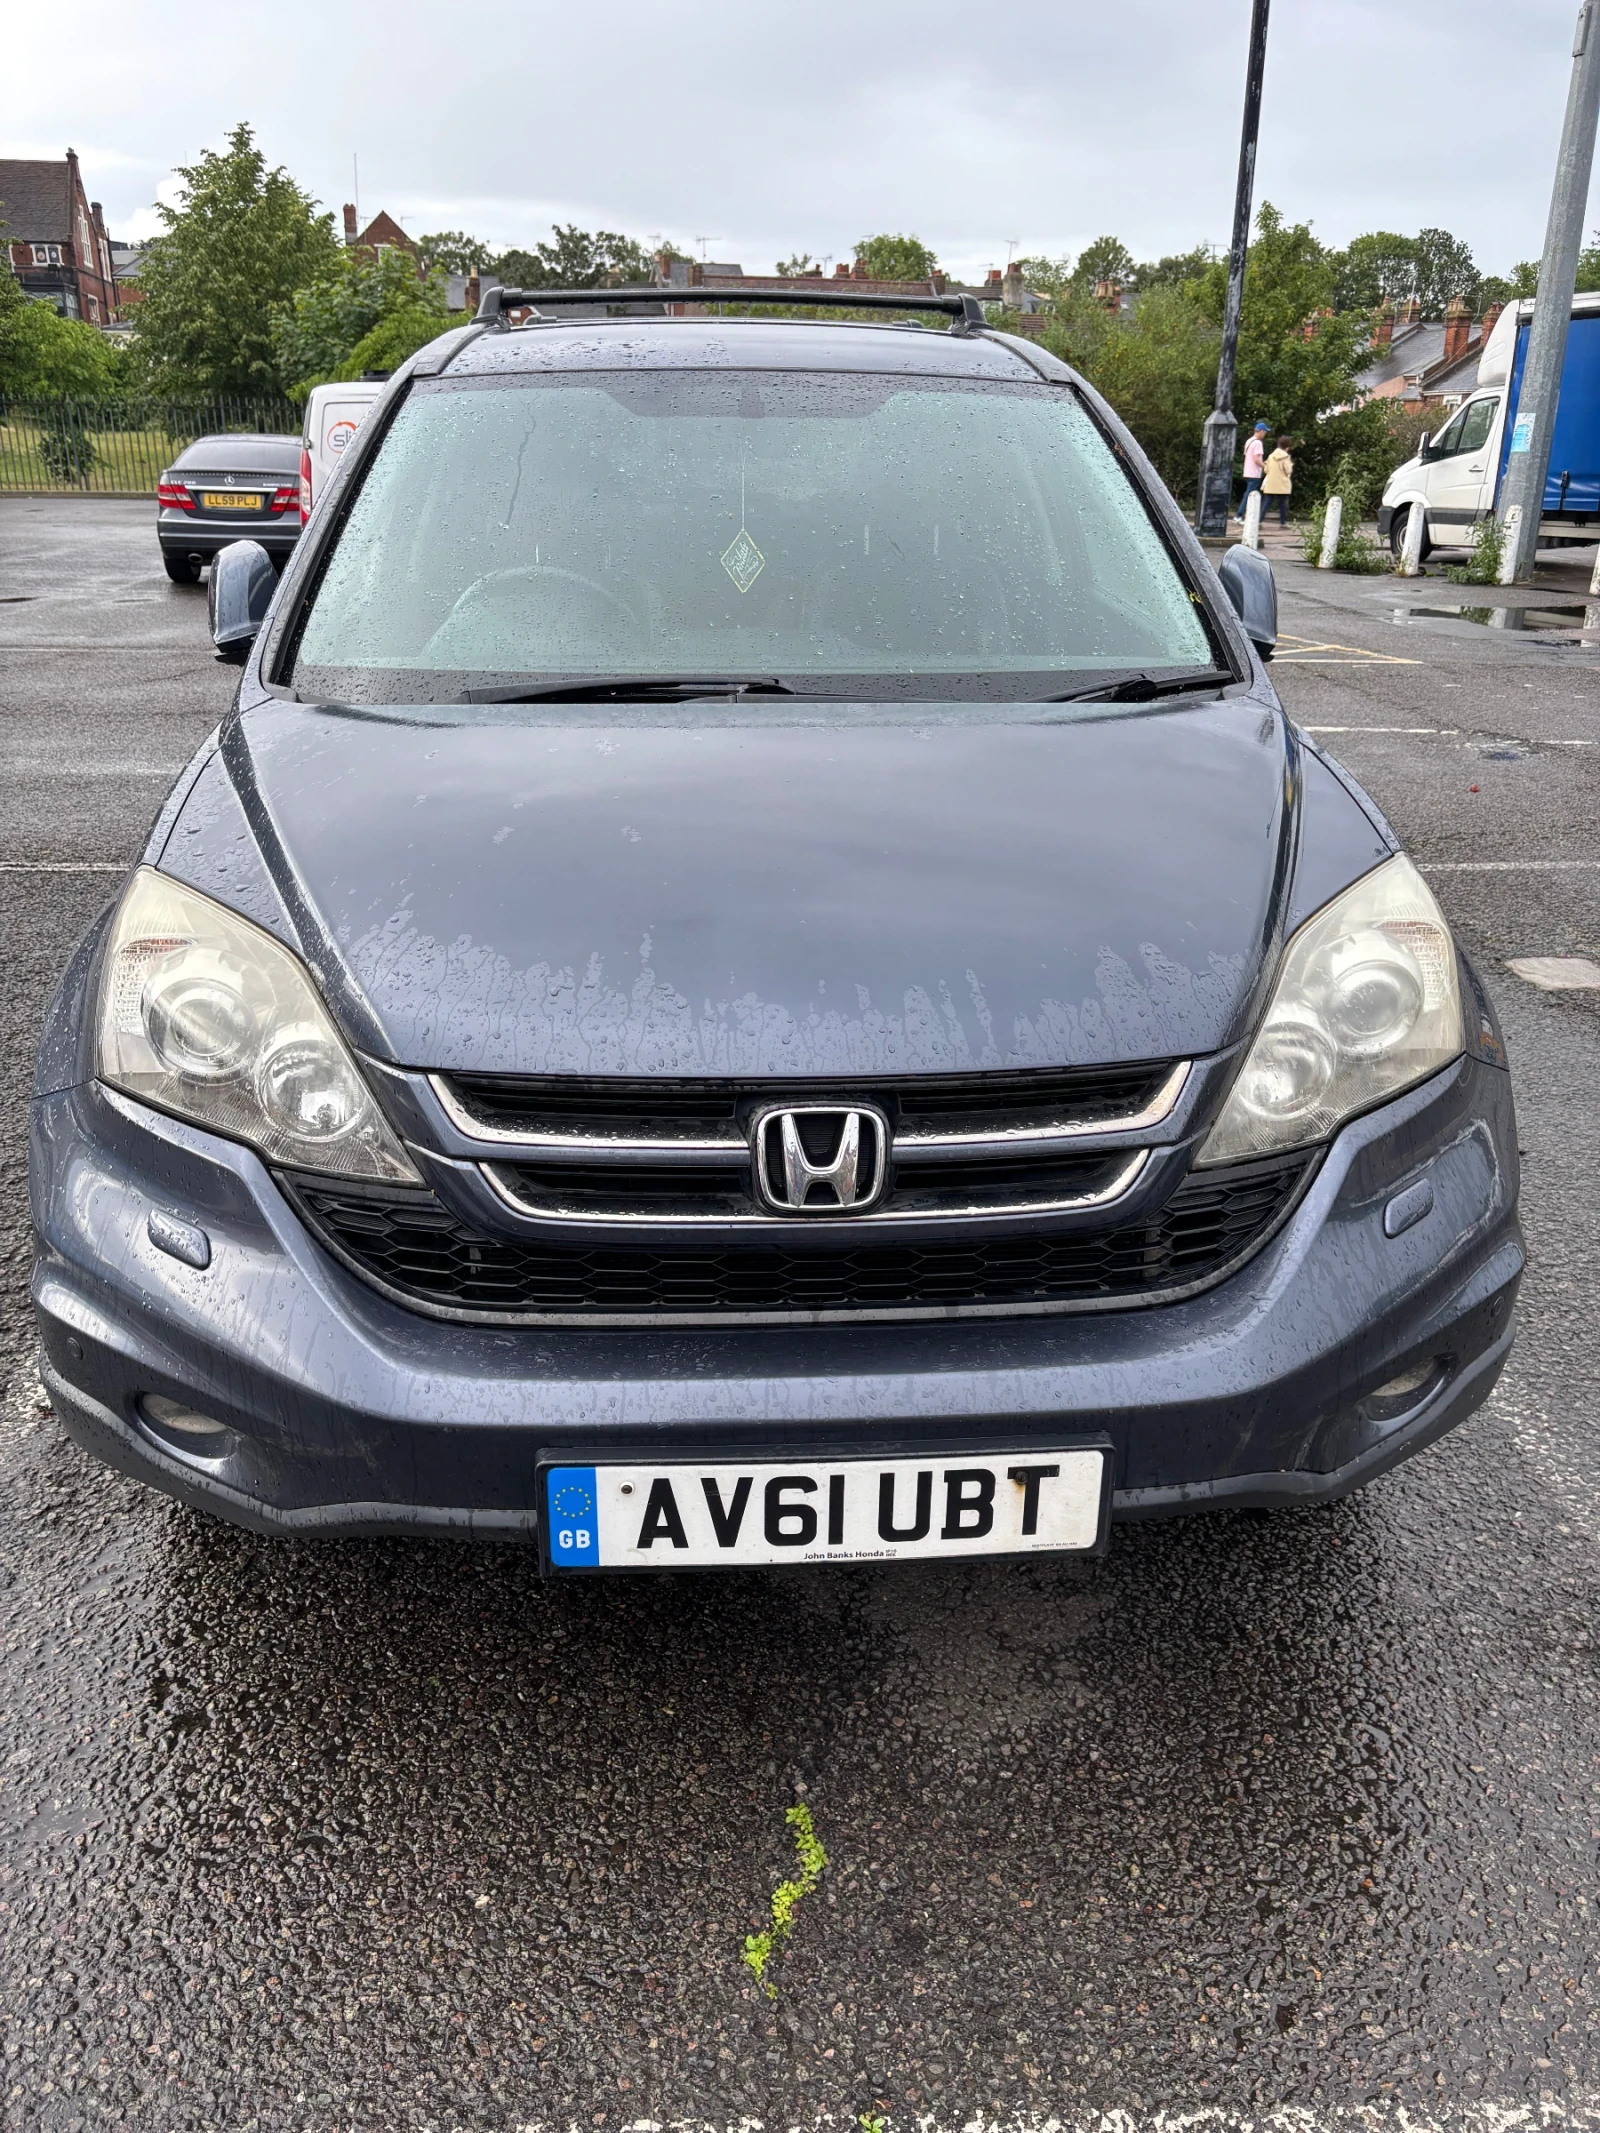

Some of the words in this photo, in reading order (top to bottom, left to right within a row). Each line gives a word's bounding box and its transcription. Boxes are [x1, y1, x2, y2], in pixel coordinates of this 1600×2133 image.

[208, 495, 235, 505] LL59
[237, 496, 257, 506] PLJ
[636, 1474, 844, 1549] AV61
[877, 1465, 1060, 1542] UBT
[558, 1529, 591, 1549] GB
[804, 1552, 825, 1560] John
[827, 1551, 853, 1559] Banks
[855, 1549, 884, 1558] Honda
